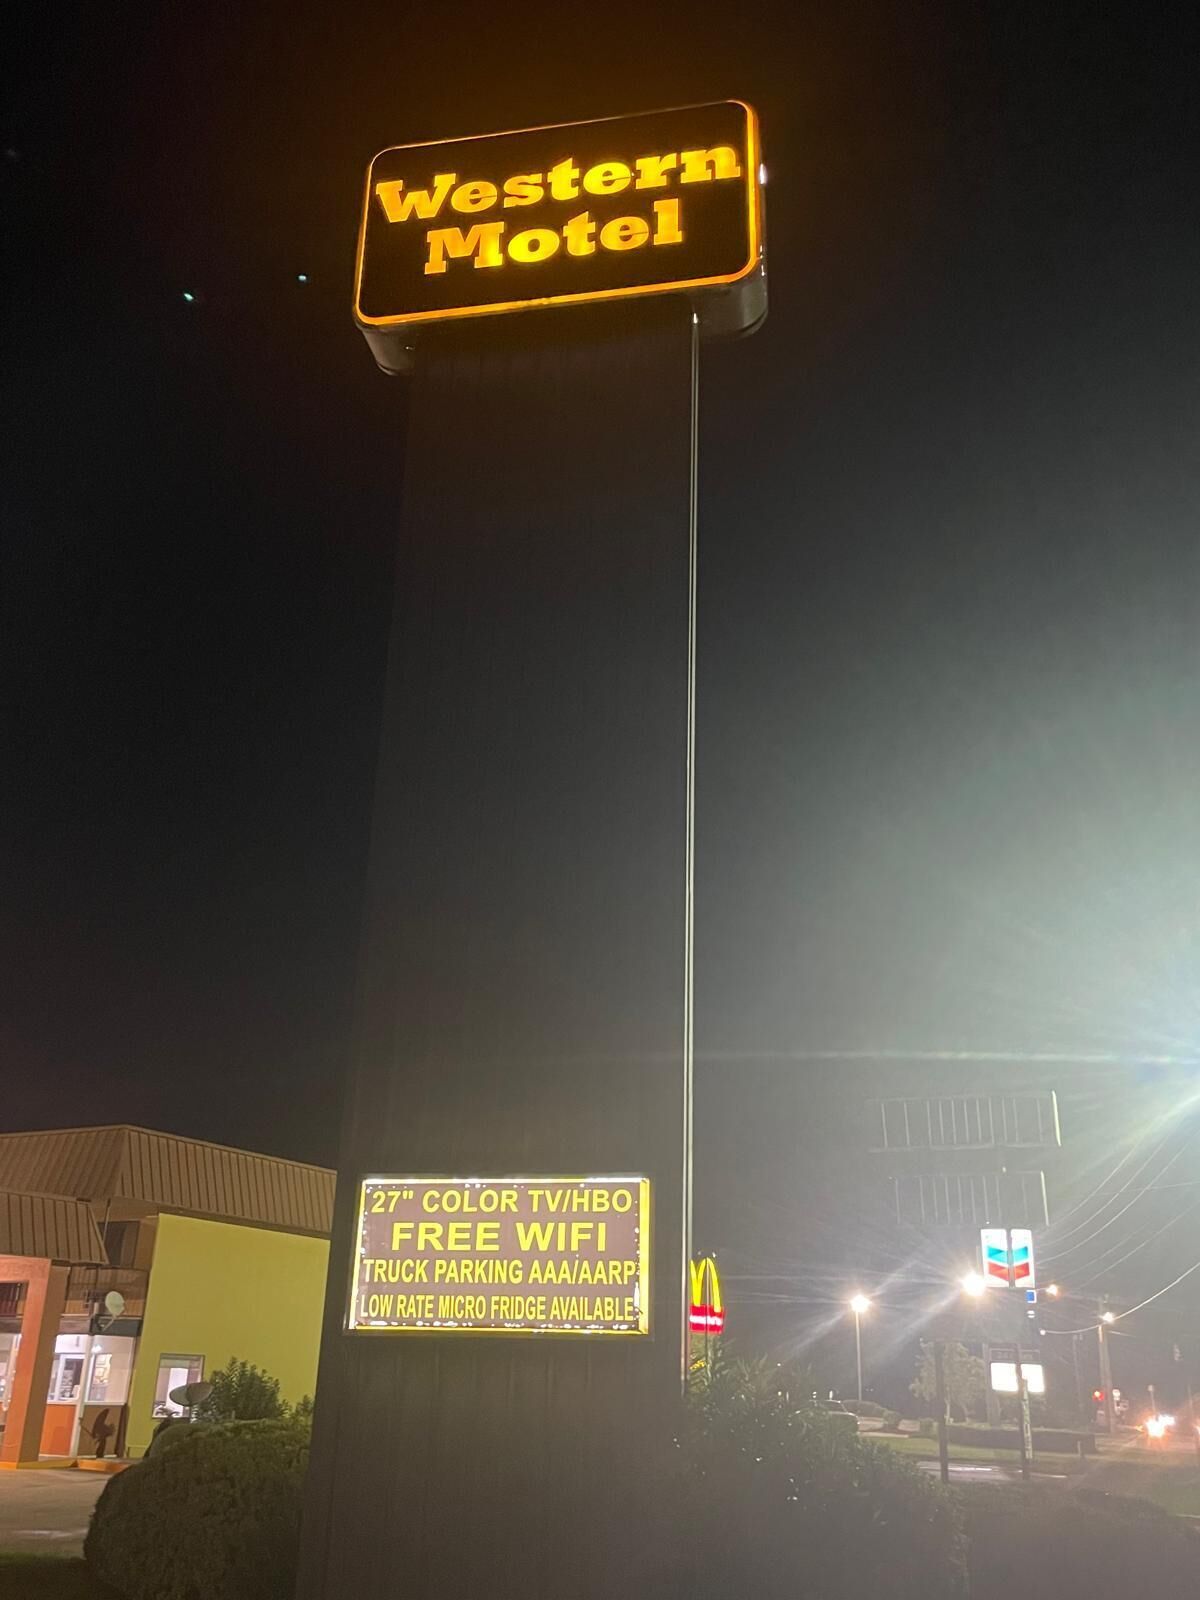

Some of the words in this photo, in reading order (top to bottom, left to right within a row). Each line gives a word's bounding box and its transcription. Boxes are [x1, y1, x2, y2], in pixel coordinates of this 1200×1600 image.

[376, 146, 741, 223] Western
[424, 198, 684, 275] Motel
[371, 1189, 414, 1213] 27"
[422, 1189, 519, 1213] COLOR
[528, 1189, 632, 1213] TV/HBO
[391, 1222, 500, 1252] FREE
[515, 1222, 607, 1252] WIFI
[362, 1259, 429, 1283] TRUCK
[434, 1259, 523, 1284] PARKING
[528, 1259, 637, 1285] AAA/AARP
[360, 1294, 395, 1318] LOW
[396, 1294, 434, 1319] RATE
[438, 1295, 486, 1320] MICRO
[491, 1296, 546, 1321] FRIDGE
[550, 1296, 634, 1321] AVAILABLE
